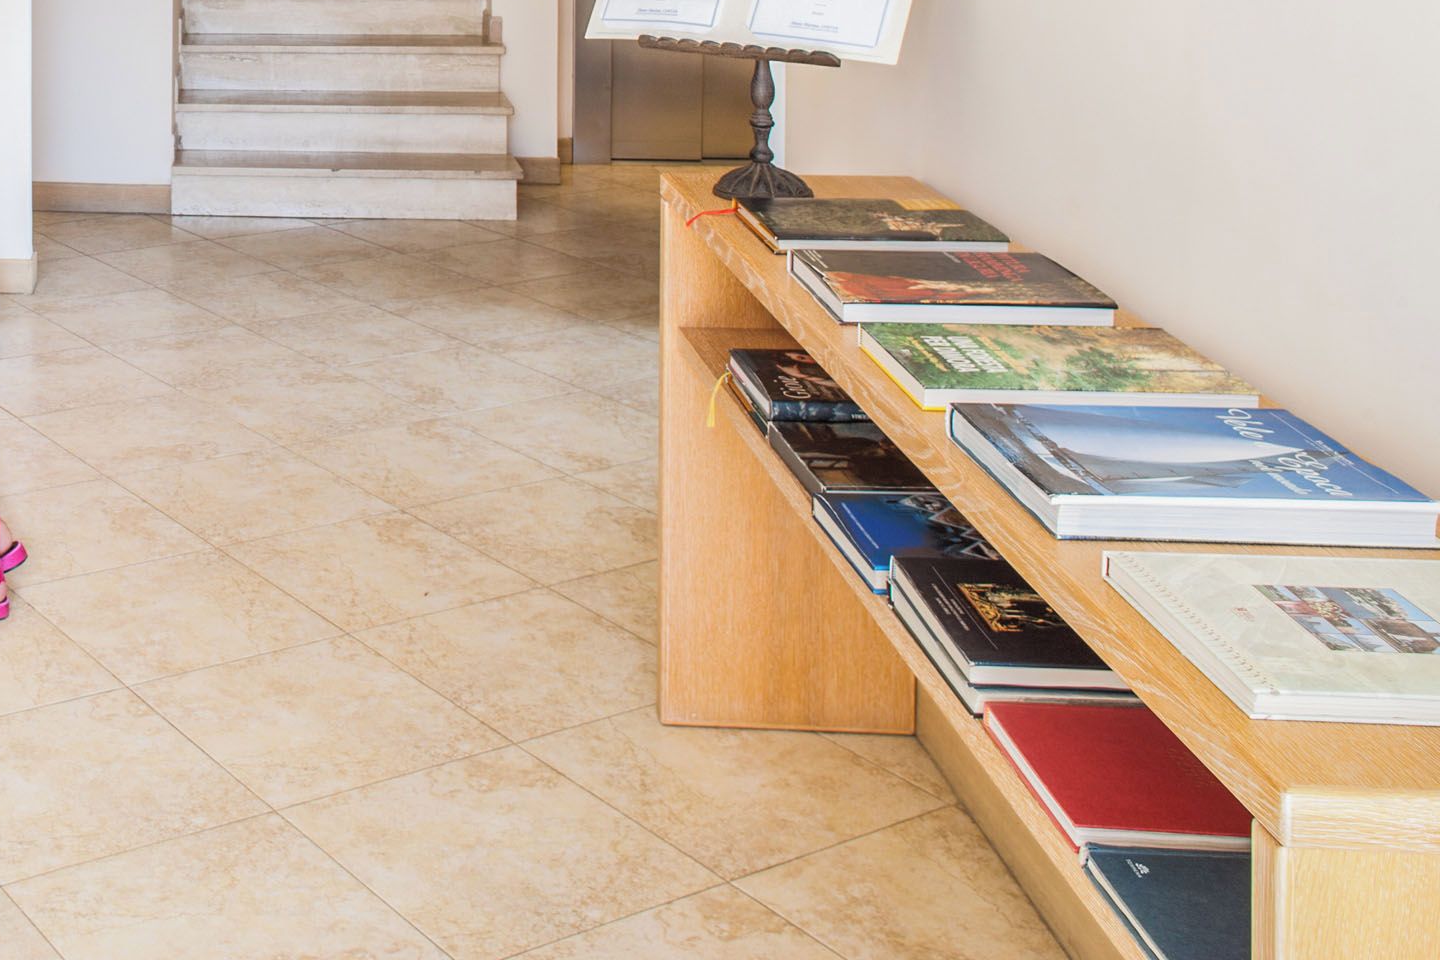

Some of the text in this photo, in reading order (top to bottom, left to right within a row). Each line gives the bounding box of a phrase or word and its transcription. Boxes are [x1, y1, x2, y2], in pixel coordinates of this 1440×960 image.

[920, 335, 952, 347] PER
[947, 336, 980, 348] UNA
[933, 347, 980, 373] DIMORA
[1216, 408, 1274, 440] Vele
